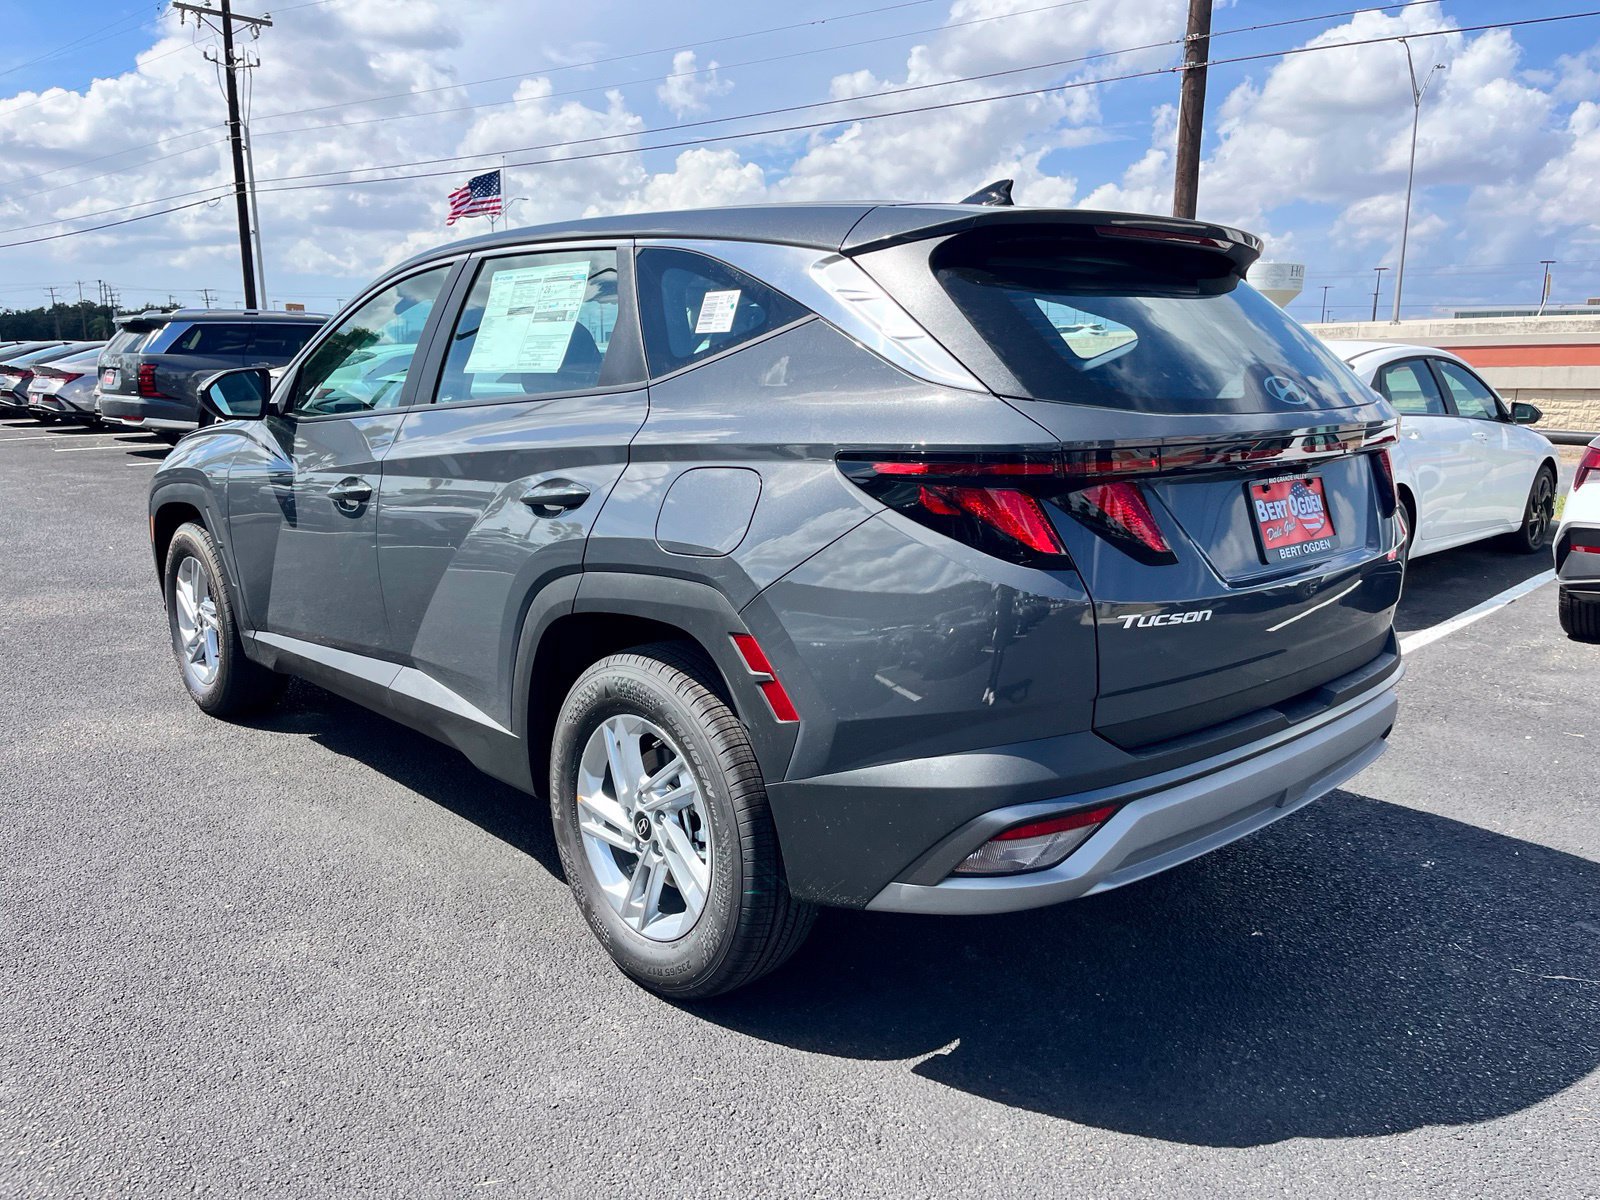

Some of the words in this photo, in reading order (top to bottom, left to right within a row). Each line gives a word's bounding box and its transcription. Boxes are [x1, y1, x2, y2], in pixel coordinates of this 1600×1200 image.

[1277, 475, 1293, 483] GRANDE
[1294, 473, 1307, 481] VALLEY
[1255, 499, 1288, 522] BERT
[1288, 494, 1324, 516] OGDEN
[1279, 546, 1301, 559] BERT
[1302, 539, 1331, 554] OGDEN
[664, 711, 716, 798] CRUGEN
[552, 738, 565, 820] KUMHO
